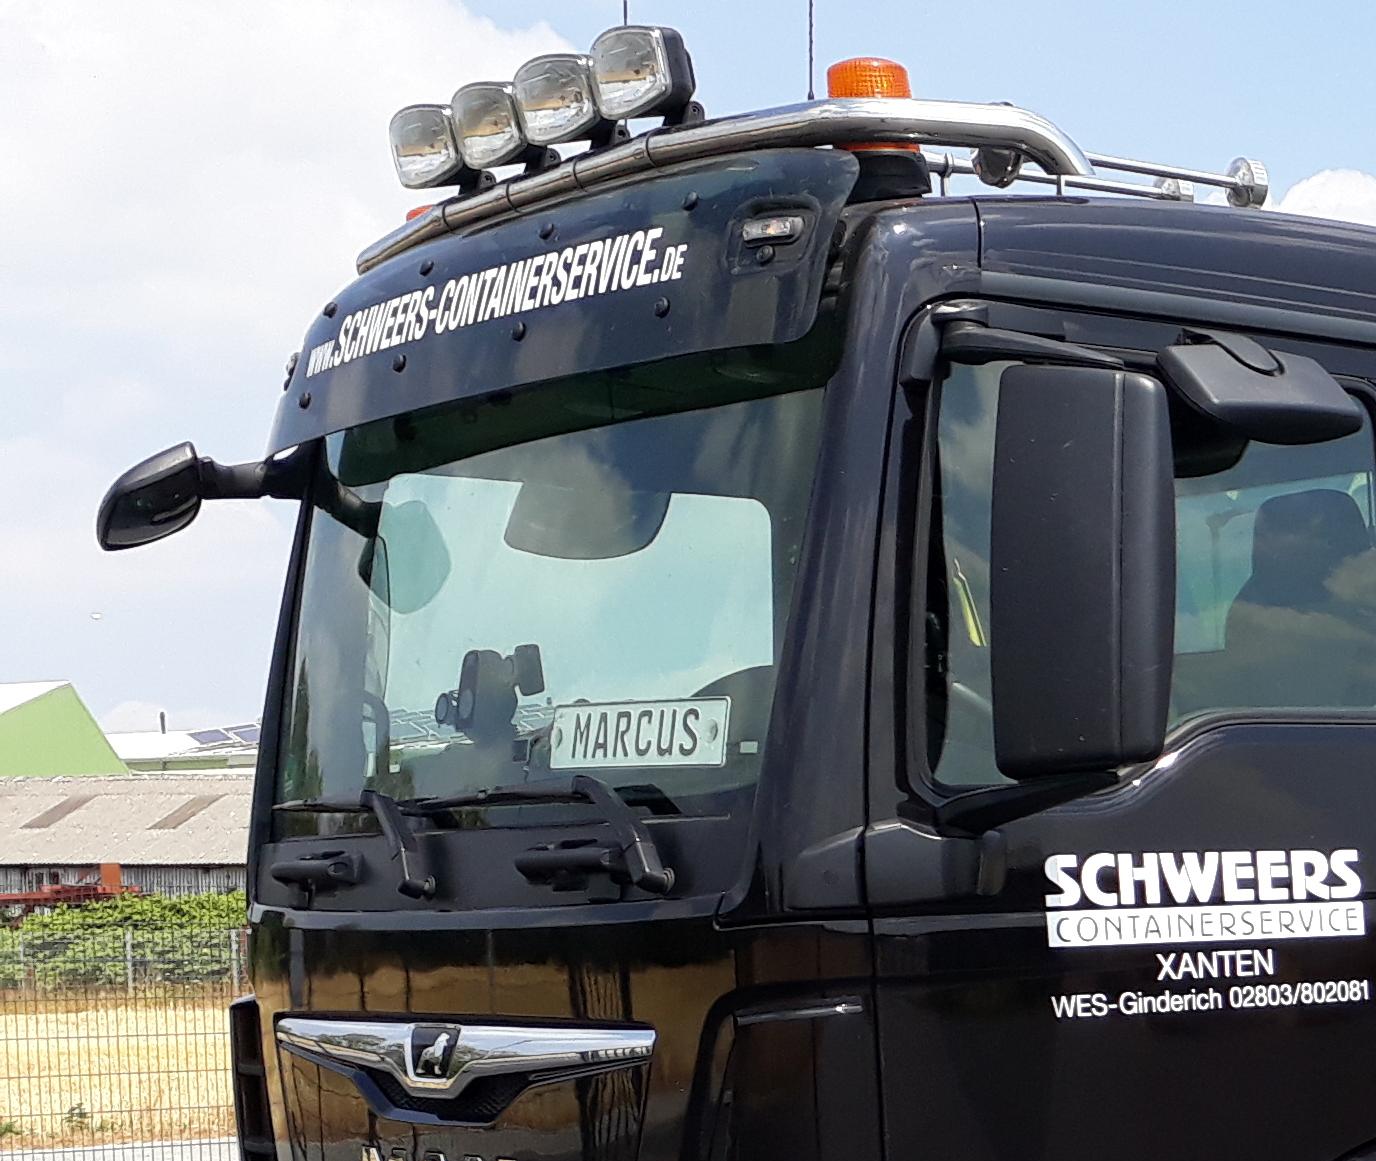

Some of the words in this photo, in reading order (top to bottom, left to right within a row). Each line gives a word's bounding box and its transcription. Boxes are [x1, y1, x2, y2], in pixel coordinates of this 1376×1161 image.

[571, 707, 700, 759] MARCUS
[1044, 849, 1362, 907] SCHWEERS
[1056, 908, 1359, 943] CONTAINERSERVICE
[1156, 949, 1274, 981] XANTEN
[1051, 986, 1223, 1019] WES-Ginderich
[1229, 979, 1370, 1009] 02803/802081
